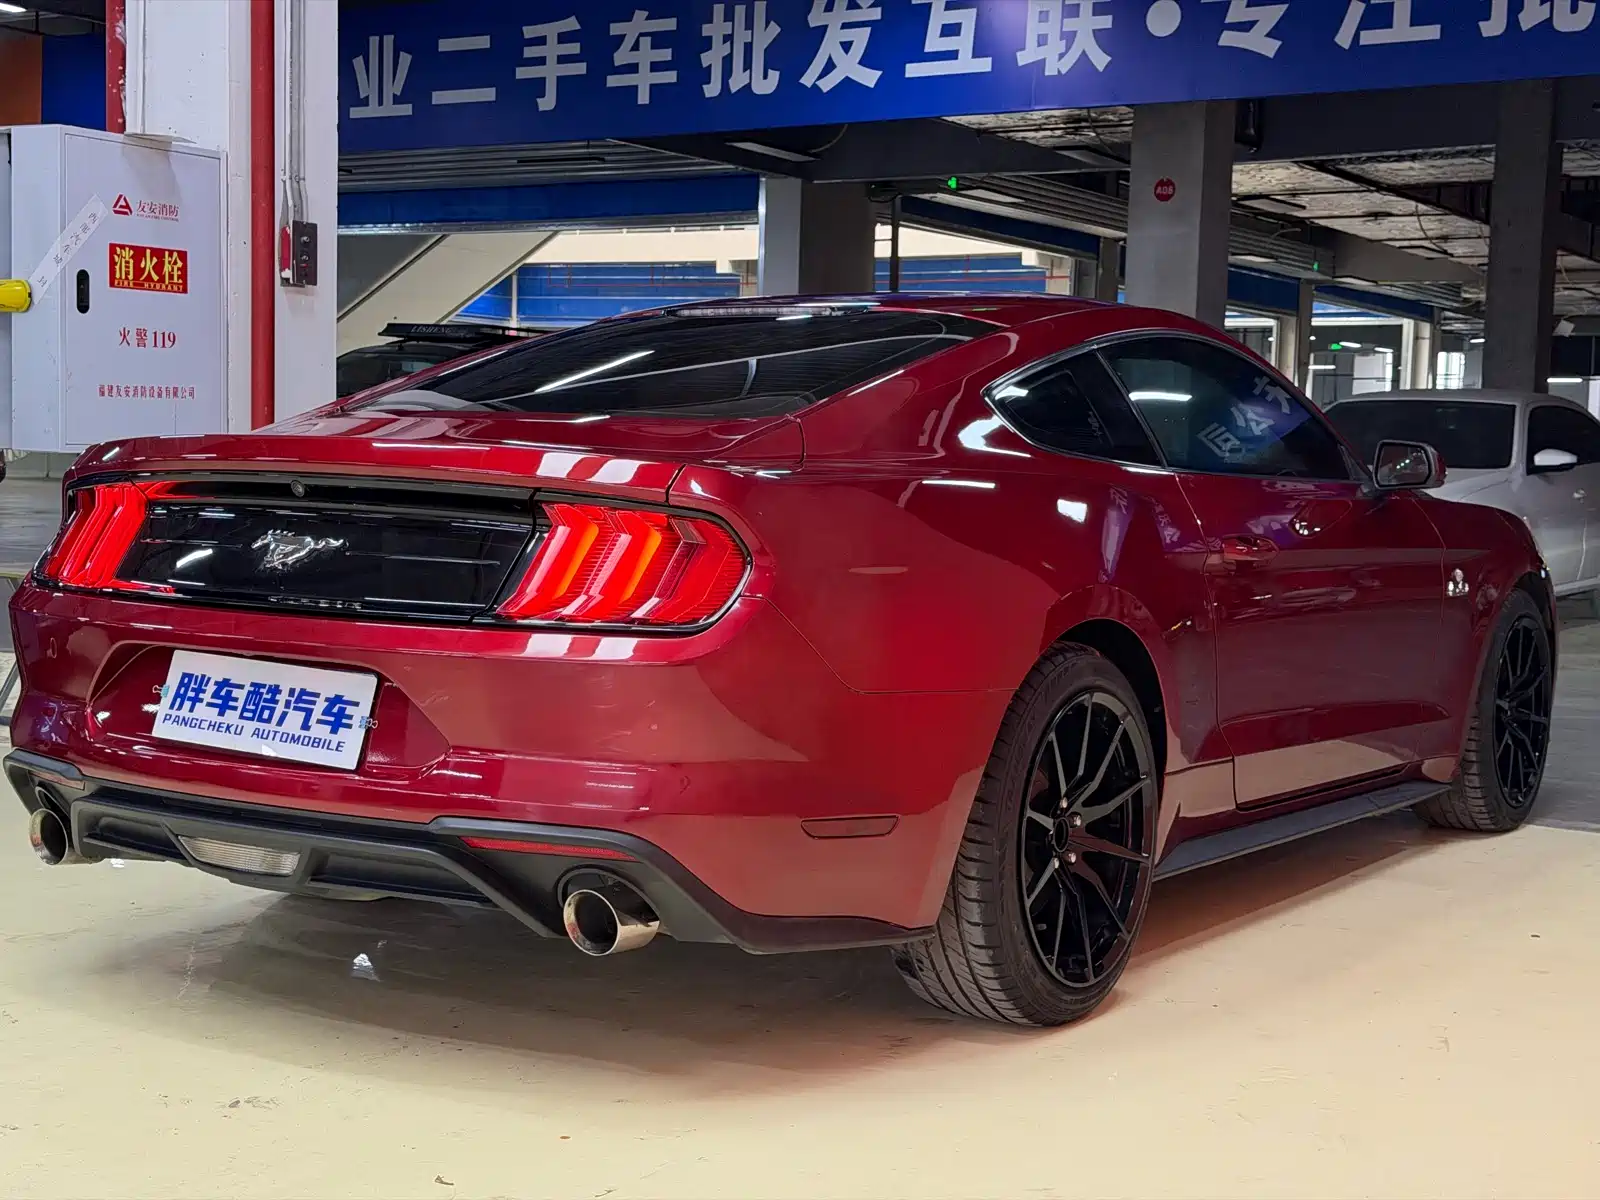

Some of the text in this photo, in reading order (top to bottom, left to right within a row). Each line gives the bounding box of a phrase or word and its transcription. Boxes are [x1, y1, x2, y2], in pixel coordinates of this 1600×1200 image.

[136, 200, 180, 218] 友安消防
[113, 246, 184, 285] 消火栓
[98, 384, 195, 400] 福建友安消防设备有限公司
[168, 671, 361, 735] 胖车酷汽车
[162, 713, 346, 753] PANGCHEKU AUTOMOBILE
